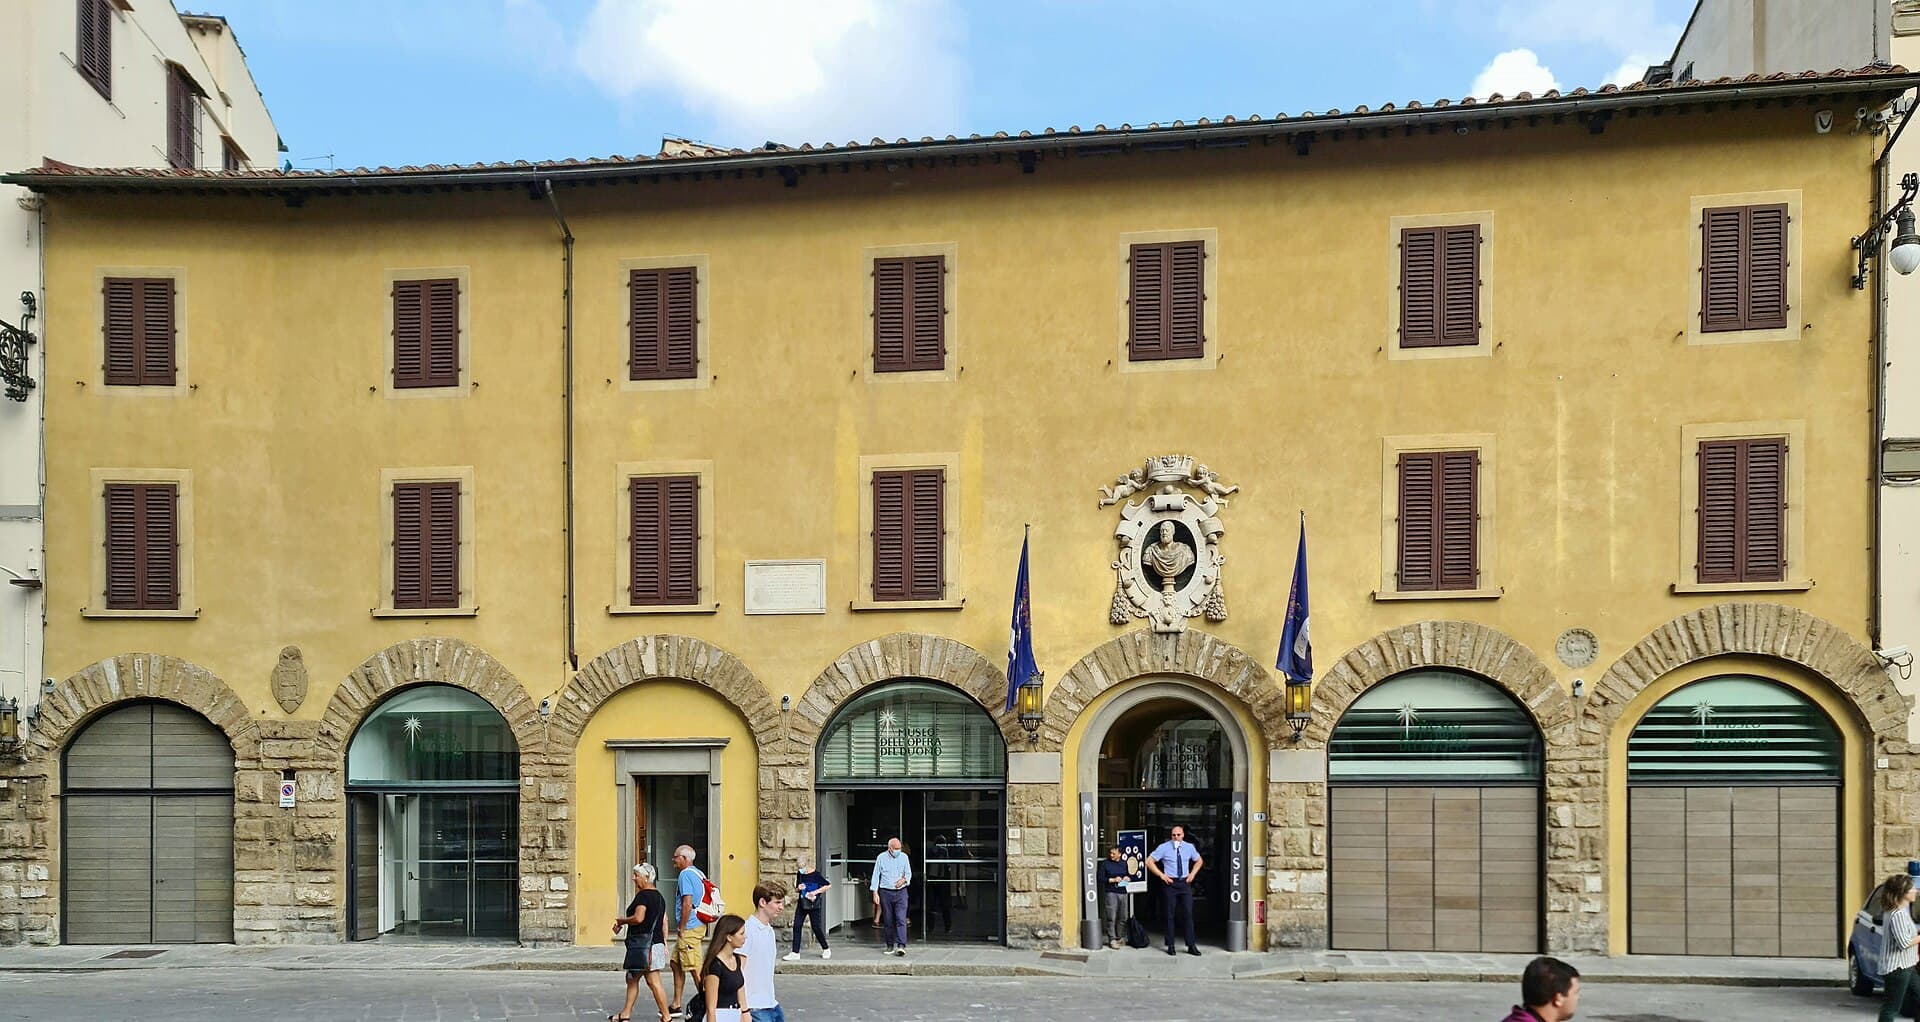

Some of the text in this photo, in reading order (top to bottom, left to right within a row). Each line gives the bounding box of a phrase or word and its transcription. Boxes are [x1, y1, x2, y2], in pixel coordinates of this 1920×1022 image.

[898, 728, 936, 737] MUSEO
[899, 747, 942, 757] DUOMO
[1169, 743, 1206, 754] MUSEO
[1083, 823, 1097, 902] MUSEO
[1230, 823, 1244, 903] MUSEO
